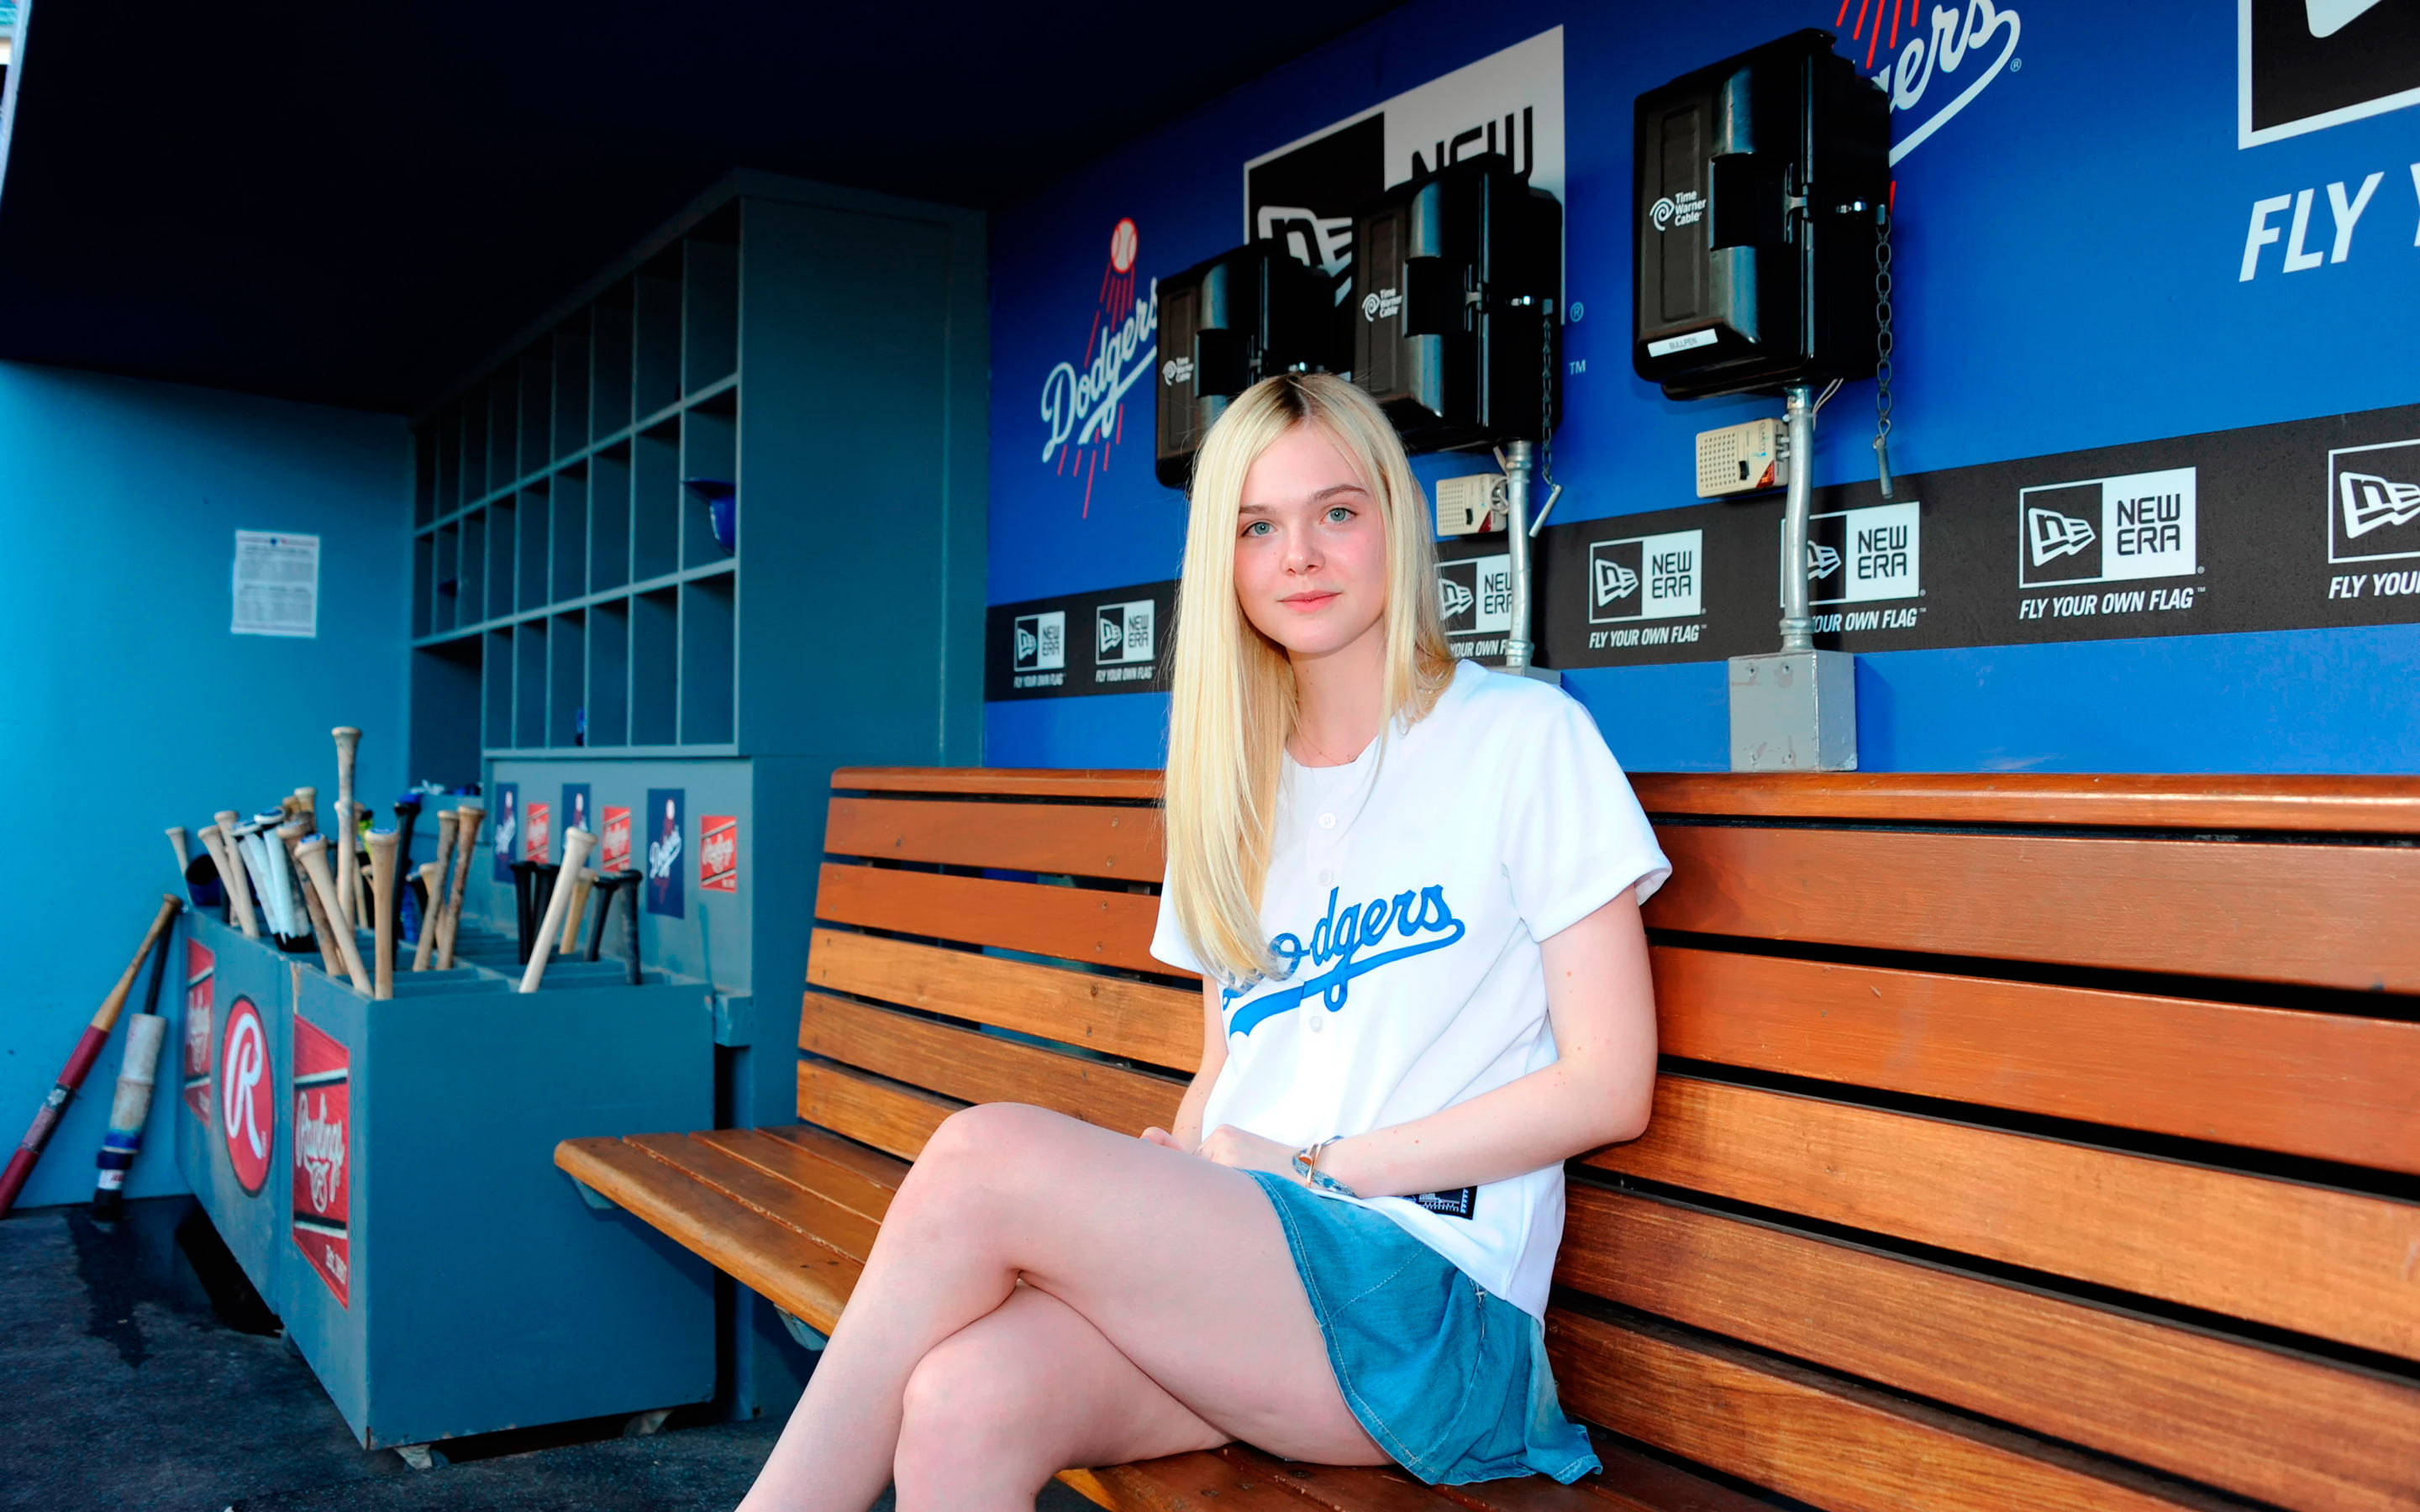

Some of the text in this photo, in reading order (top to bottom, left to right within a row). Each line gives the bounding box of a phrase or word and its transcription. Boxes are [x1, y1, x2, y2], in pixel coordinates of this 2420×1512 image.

[1676, 191, 1697, 203] Time
[1676, 199, 1707, 215] Warner
[1675, 212, 1701, 227] Cable
[2239, 171, 2385, 282] FLY
[2117, 493, 2181, 527] NEW
[1858, 525, 1907, 554] NEW
[2117, 523, 2181, 556] ERA
[1652, 550, 1692, 576] NEW
[1858, 552, 1907, 580] ERA
[1652, 575, 1691, 599] ERA
[2328, 570, 2420, 600] FLY YOU
[2018, 587, 2195, 620] FLY YOUR OWN FLAG
[1128, 615, 1149, 631] NEW
[1812, 607, 1918, 633] OUR OWN FLAG
[1128, 632, 1149, 648] ERA
[1475, 639, 1499, 655] OWN
[1589, 624, 1700, 648] FLY YOUR OWN FLAG
[1223, 885, 1465, 1021] odgers
[225, 1013, 263, 1159] R
